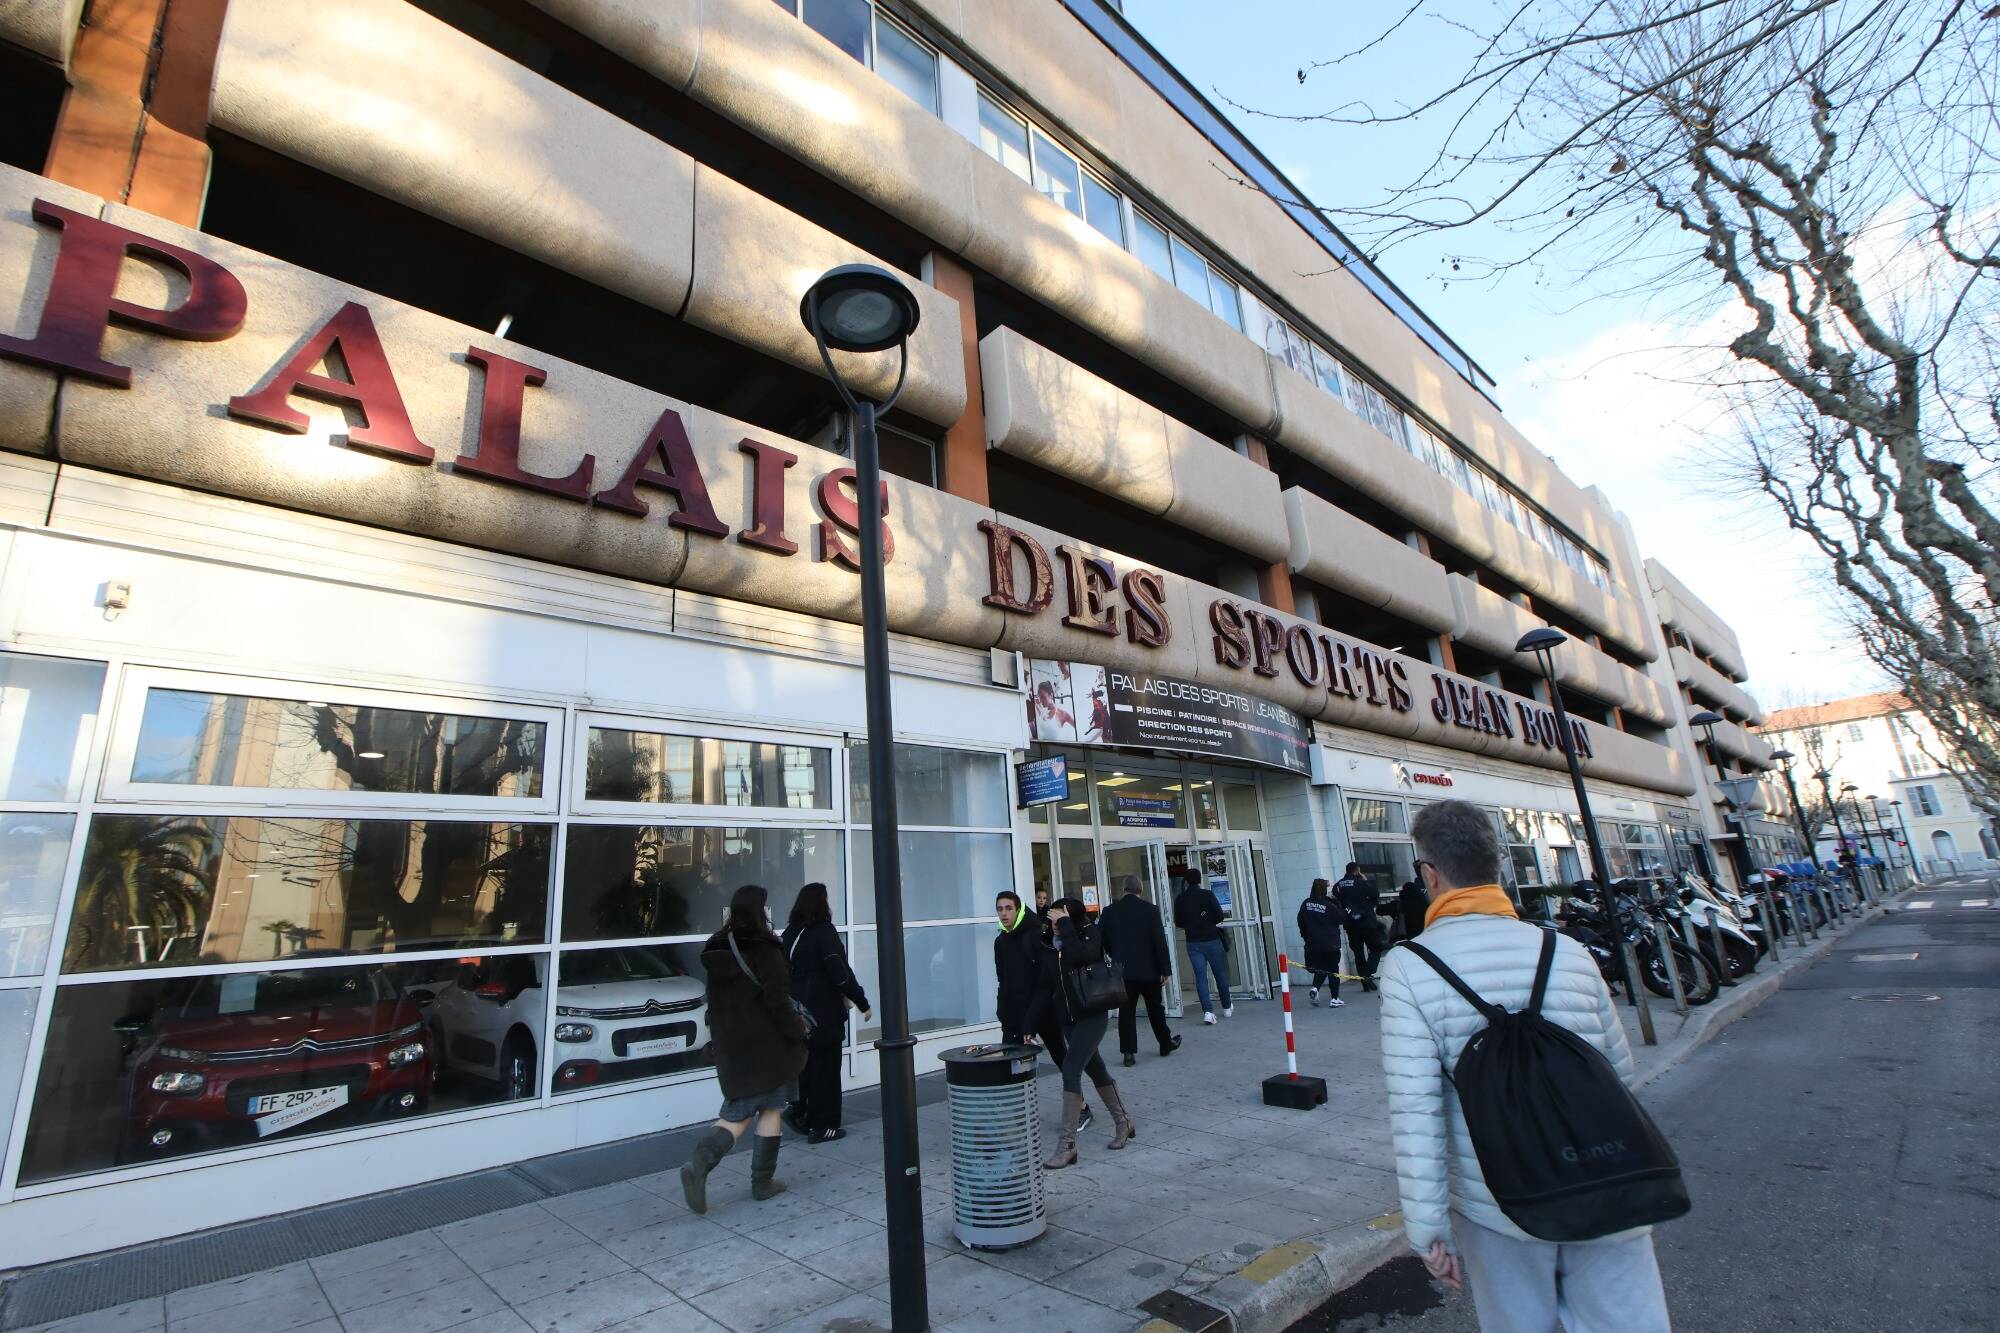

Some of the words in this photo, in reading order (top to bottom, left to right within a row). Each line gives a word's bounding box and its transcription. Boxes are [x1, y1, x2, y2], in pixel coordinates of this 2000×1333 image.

[0, 198, 896, 573] PALAIS
[977, 518, 1174, 648] DES
[1208, 597, 1414, 713] SPORTS
[1430, 672, 1516, 739] JEAN
[1111, 673, 1169, 697] PALAIS
[1169, 681, 1200, 702] DES
[1201, 688, 1250, 712] SPORTS
[1256, 702, 1280, 722] JEAN
[1136, 705, 1173, 717] PISCINE
[1178, 711, 1218, 724] PATINOIRE
[1221, 718, 1248, 730] ESPACE
[1138, 719, 1186, 732] DIRECTION
[1186, 725, 1203, 735] DES
[1203, 728, 1233, 739] SPORTS
